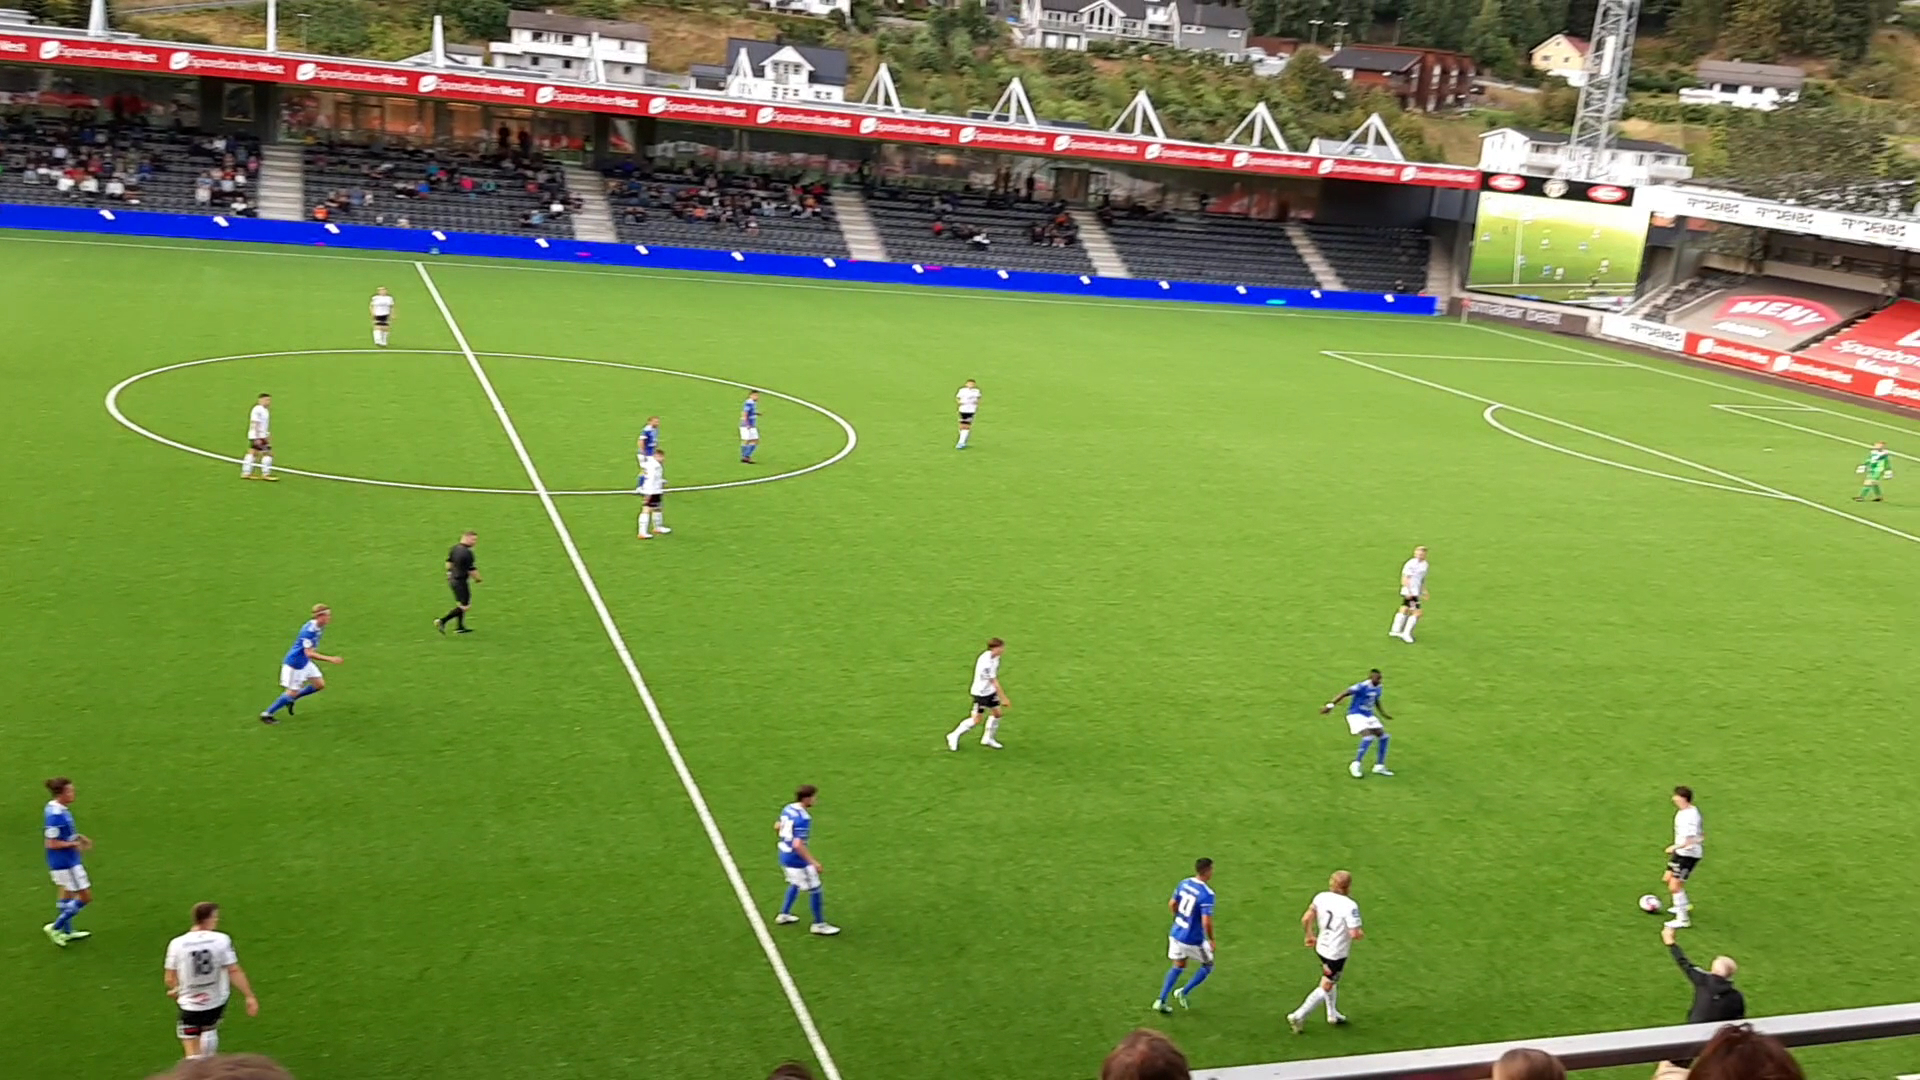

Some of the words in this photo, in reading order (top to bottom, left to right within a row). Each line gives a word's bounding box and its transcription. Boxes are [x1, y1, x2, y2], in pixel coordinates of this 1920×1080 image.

[1729, 301, 1826, 325] MENY
[1325, 909, 1334, 930] 2
[190, 950, 213, 977] 18
